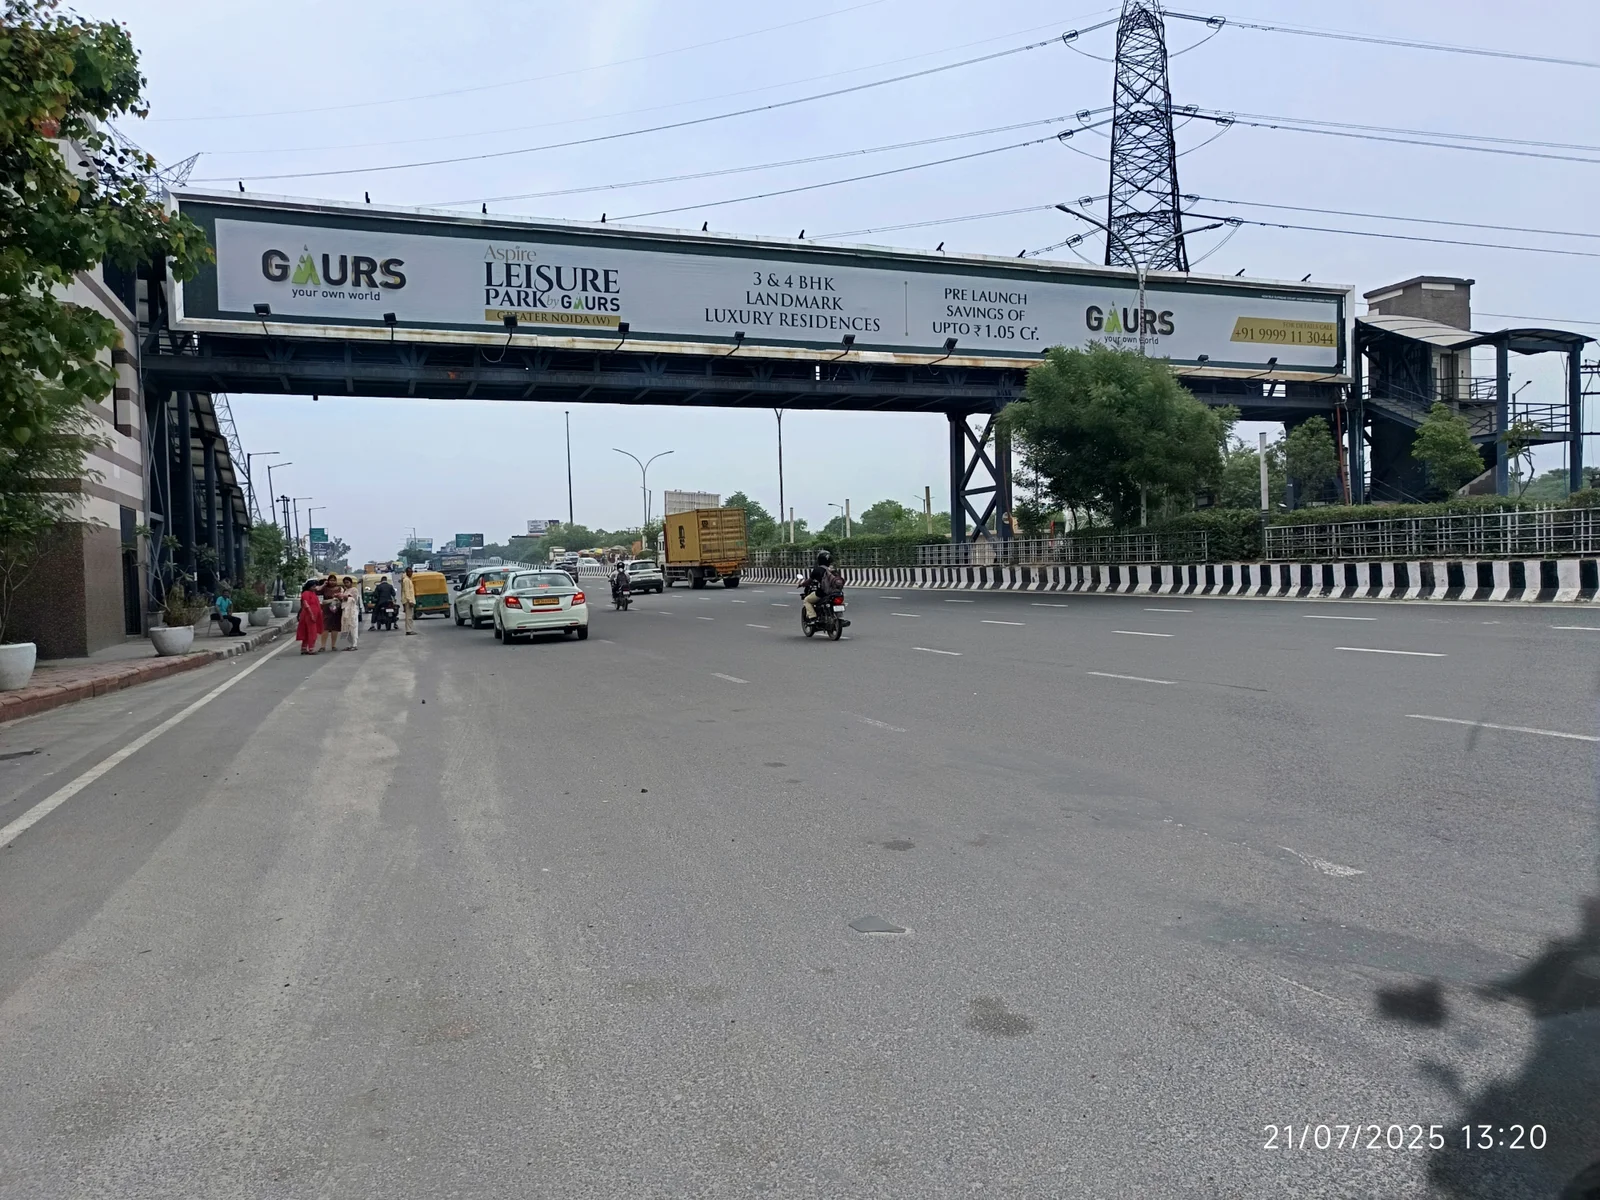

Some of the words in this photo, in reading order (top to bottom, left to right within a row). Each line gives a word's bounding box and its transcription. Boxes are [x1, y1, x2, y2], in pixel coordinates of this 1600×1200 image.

[484, 244, 537, 262] Aspire
[262, 247, 406, 290] GAURS
[484, 262, 620, 294] LEISURE
[753, 271, 762, 286] 3
[767, 273, 780, 287] &
[784, 275, 794, 288] 4
[799, 275, 836, 291] BHK
[291, 288, 318, 298] your
[321, 289, 345, 299] own
[348, 291, 381, 301] world
[484, 288, 548, 308] PARK
[547, 295, 560, 309] by
[561, 294, 620, 312] GAURS
[746, 290, 843, 311] LANDMARK
[944, 287, 968, 301] PRE
[972, 289, 1027, 305] LAUNCH
[551, 313, 592, 324] NOIDA
[592, 315, 610, 326] (W)
[705, 308, 774, 326] LUXURY
[779, 313, 881, 332] RESIDENCES
[946, 304, 1004, 321] SAVINGS
[1007, 309, 1026, 321] OF
[1086, 305, 1175, 336] GAURS
[932, 321, 970, 335] UPTO
[1235, 327, 1254, 340] +91
[1258, 328, 1287, 341] 9999
[1291, 330, 1302, 343] 11
[1306, 331, 1334, 345] 3044
[1104, 335, 1121, 344] your
[1122, 336, 1138, 344] own
[1139, 337, 1159, 345] orld
